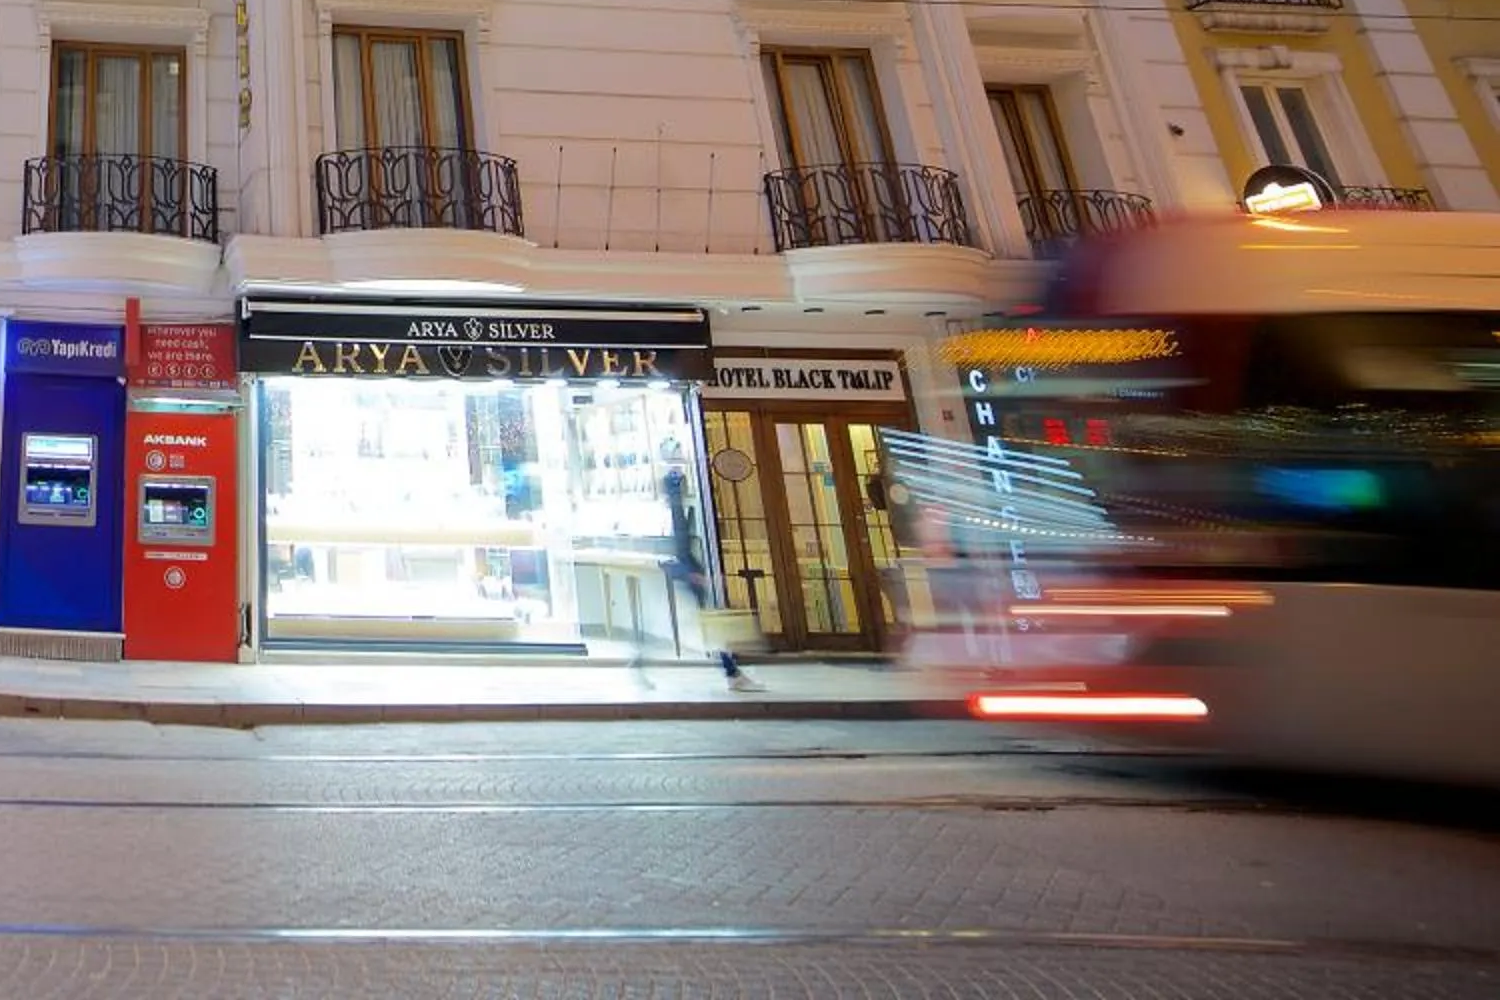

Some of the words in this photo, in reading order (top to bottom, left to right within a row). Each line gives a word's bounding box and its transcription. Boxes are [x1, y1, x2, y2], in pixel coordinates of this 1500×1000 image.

[407, 321, 458, 338] ARYA
[291, 341, 432, 376] ARYA
[485, 347, 664, 377] SILVER
[772, 369, 835, 389] BLACK
[838, 370, 893, 390] TULIP
[144, 435, 207, 447] AKBANK
